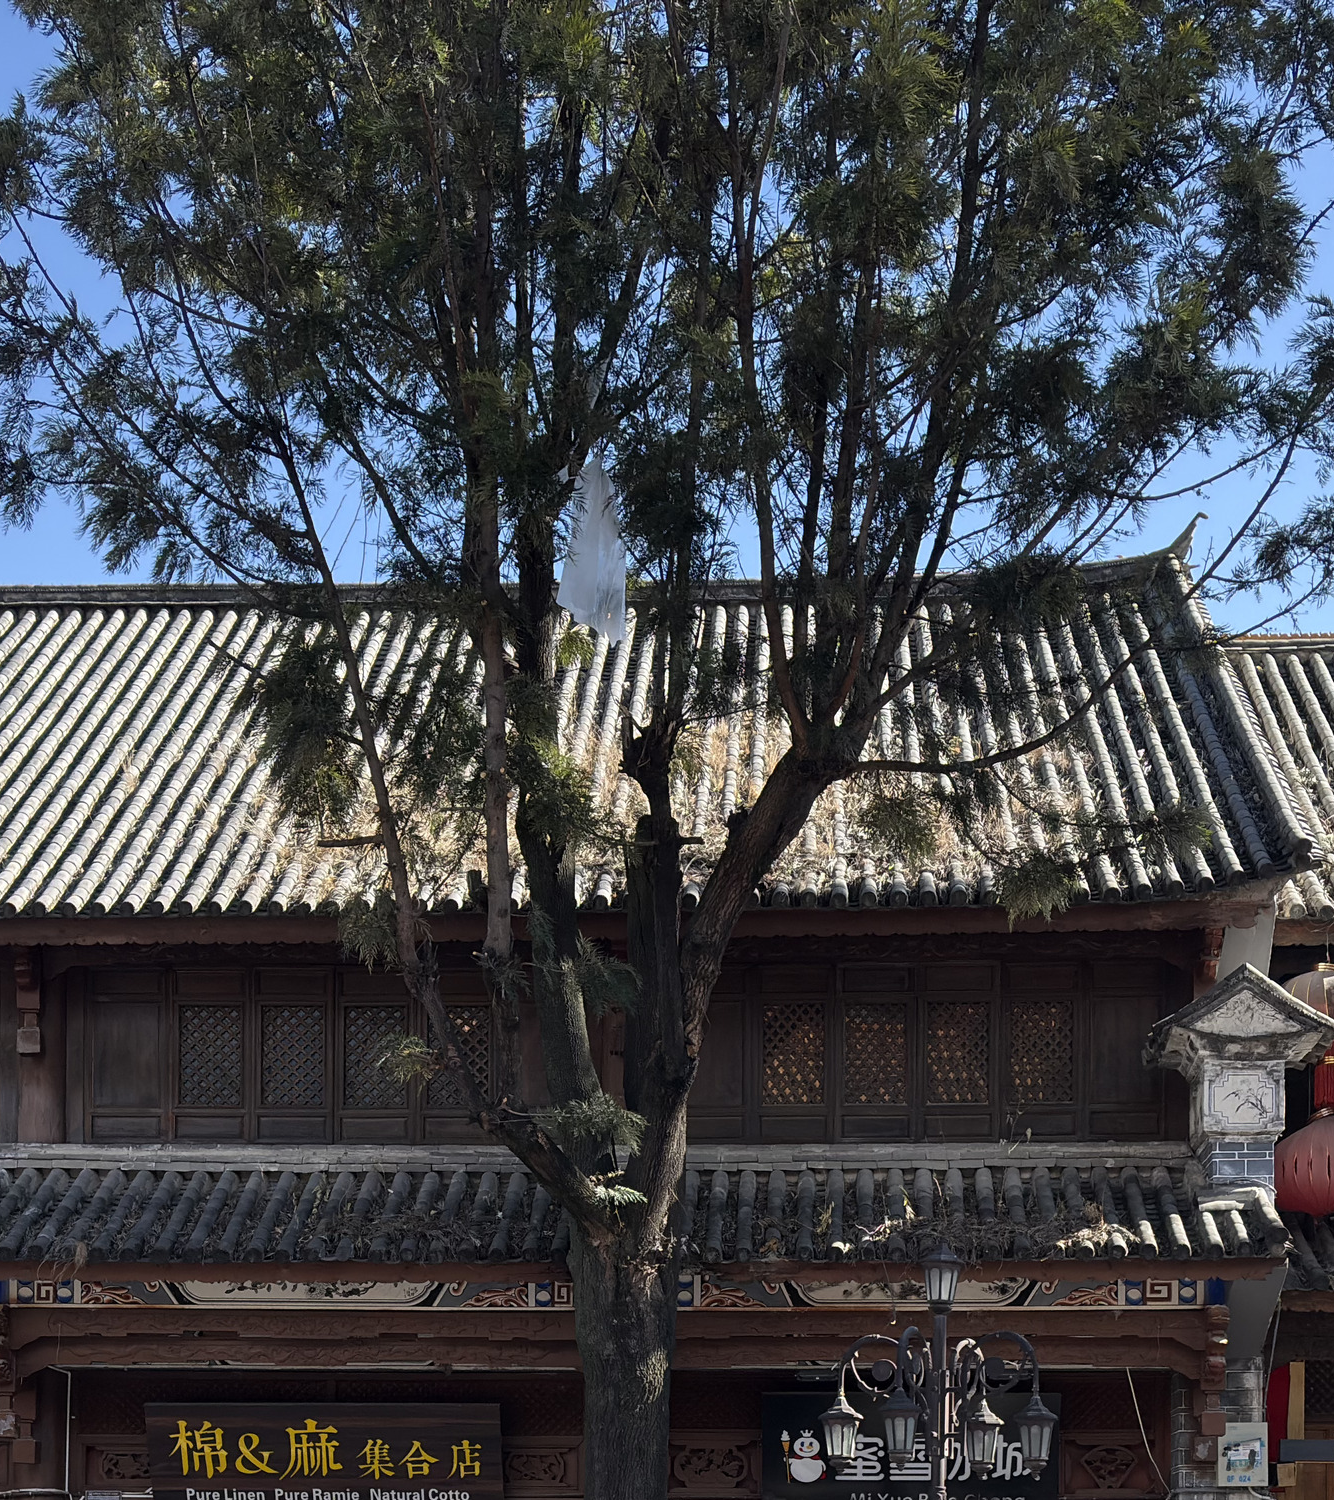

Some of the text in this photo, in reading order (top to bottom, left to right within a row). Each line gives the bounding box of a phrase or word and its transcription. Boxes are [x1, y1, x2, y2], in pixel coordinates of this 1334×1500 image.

[168, 1418, 483, 1481] 棉&麻 集合店
